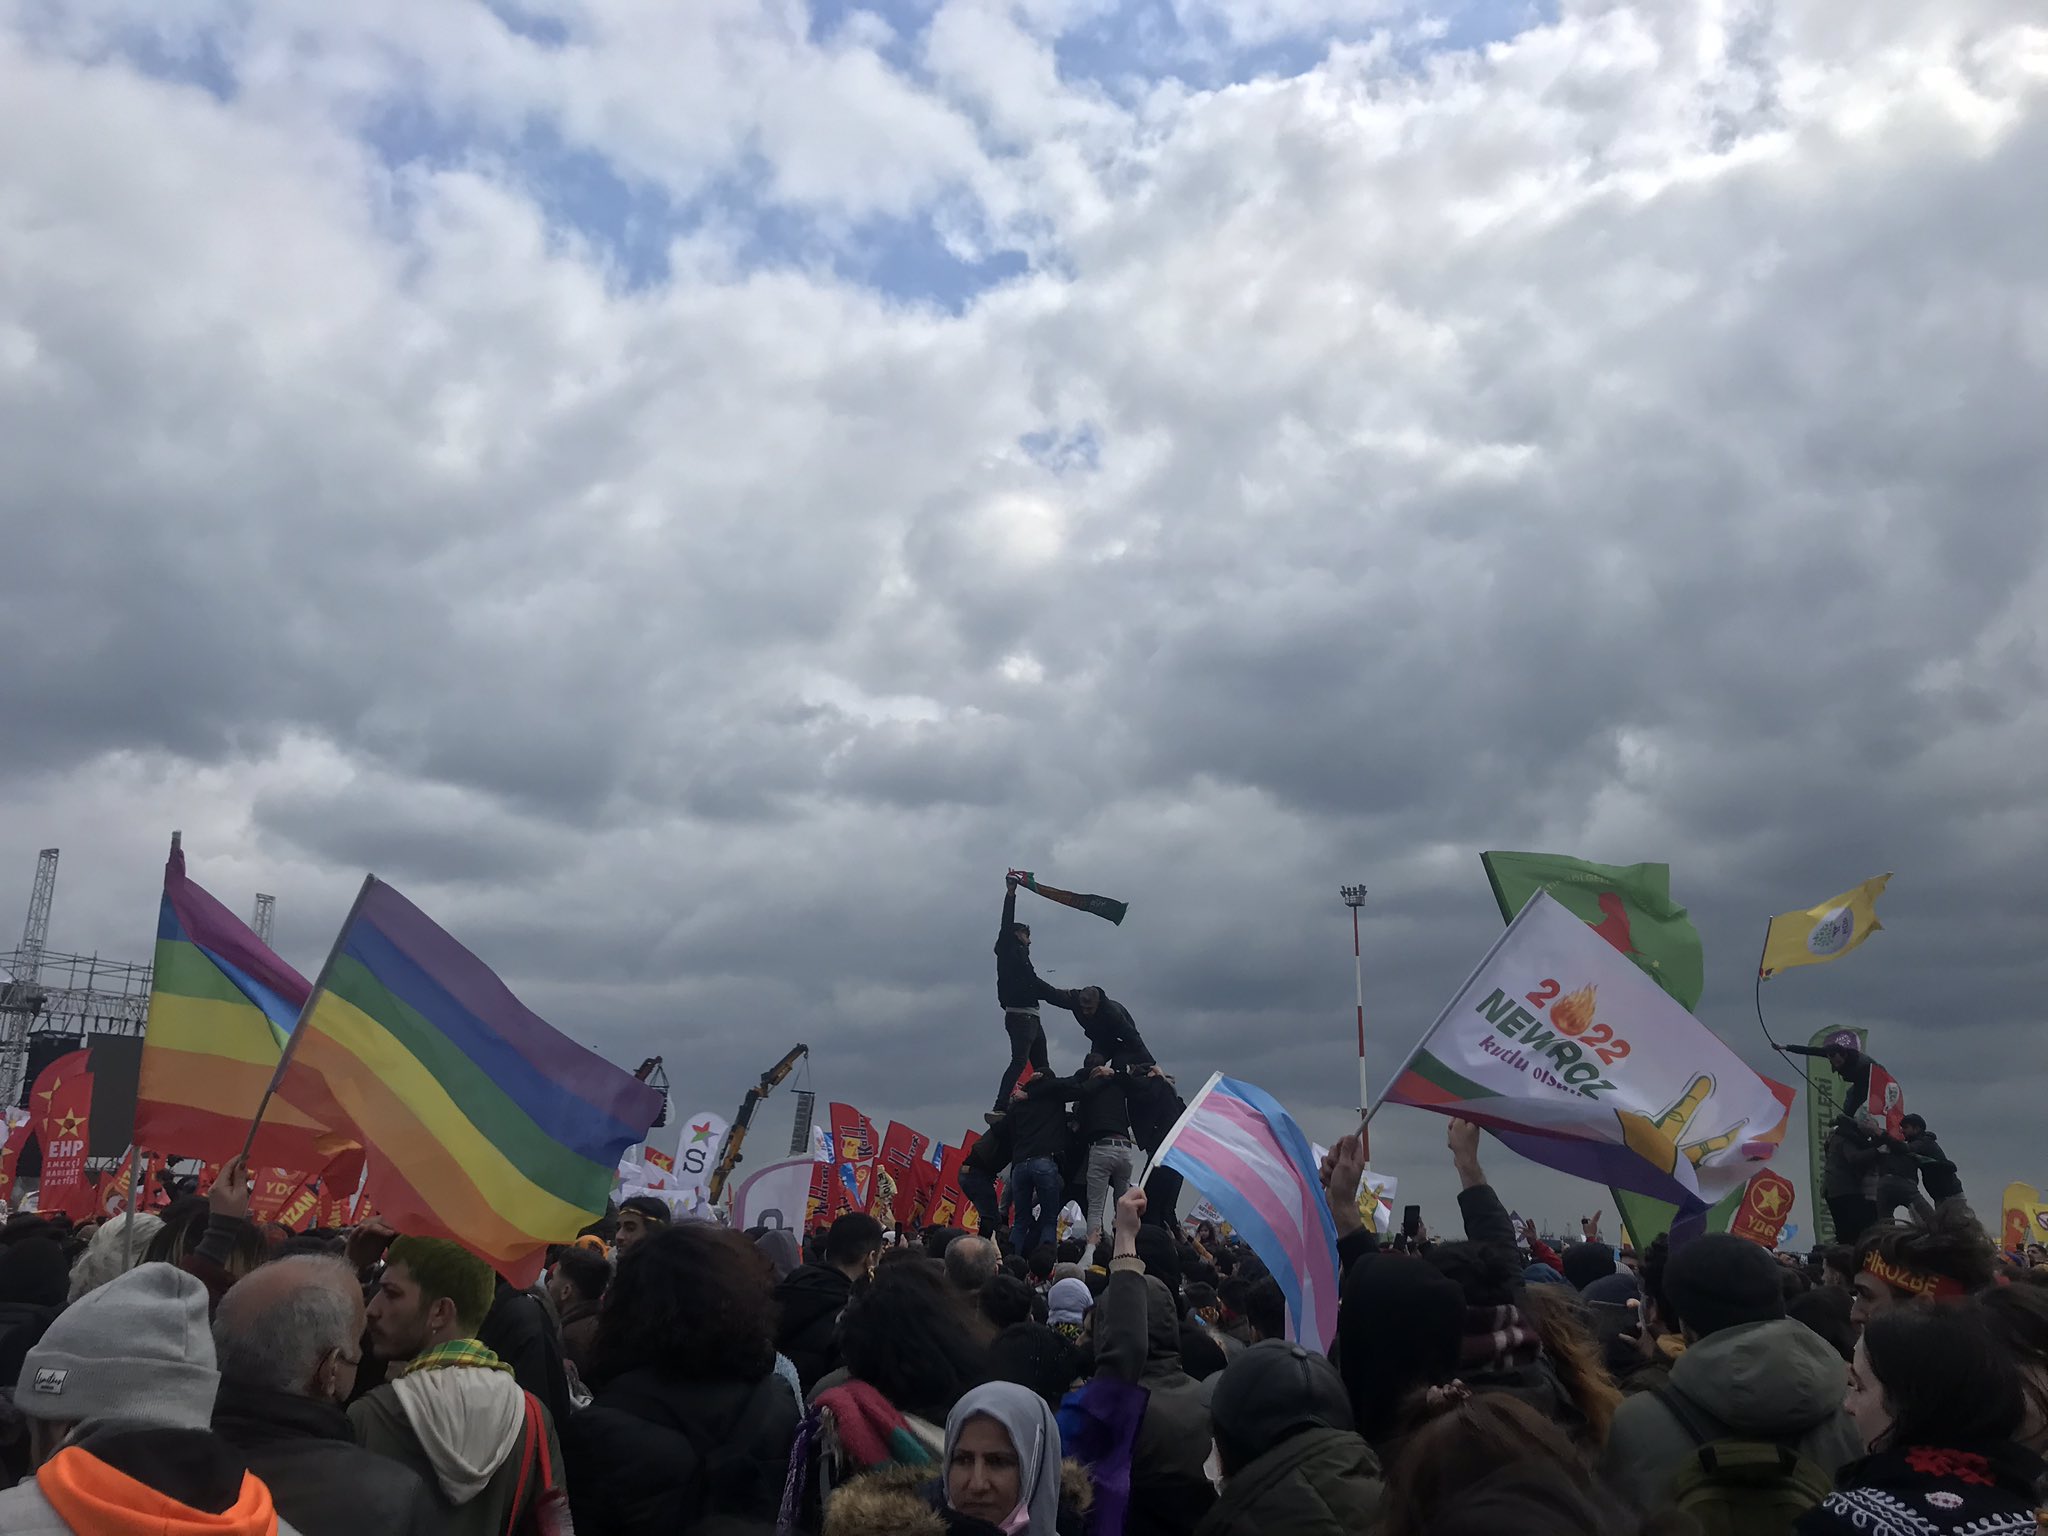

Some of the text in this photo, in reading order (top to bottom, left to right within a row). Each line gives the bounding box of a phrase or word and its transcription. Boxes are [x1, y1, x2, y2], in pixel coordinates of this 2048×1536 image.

[1475, 987, 1618, 1101] NEWROZ
[1479, 1035, 1530, 1072] kutlu
[48, 1140, 84, 1158] EHP
